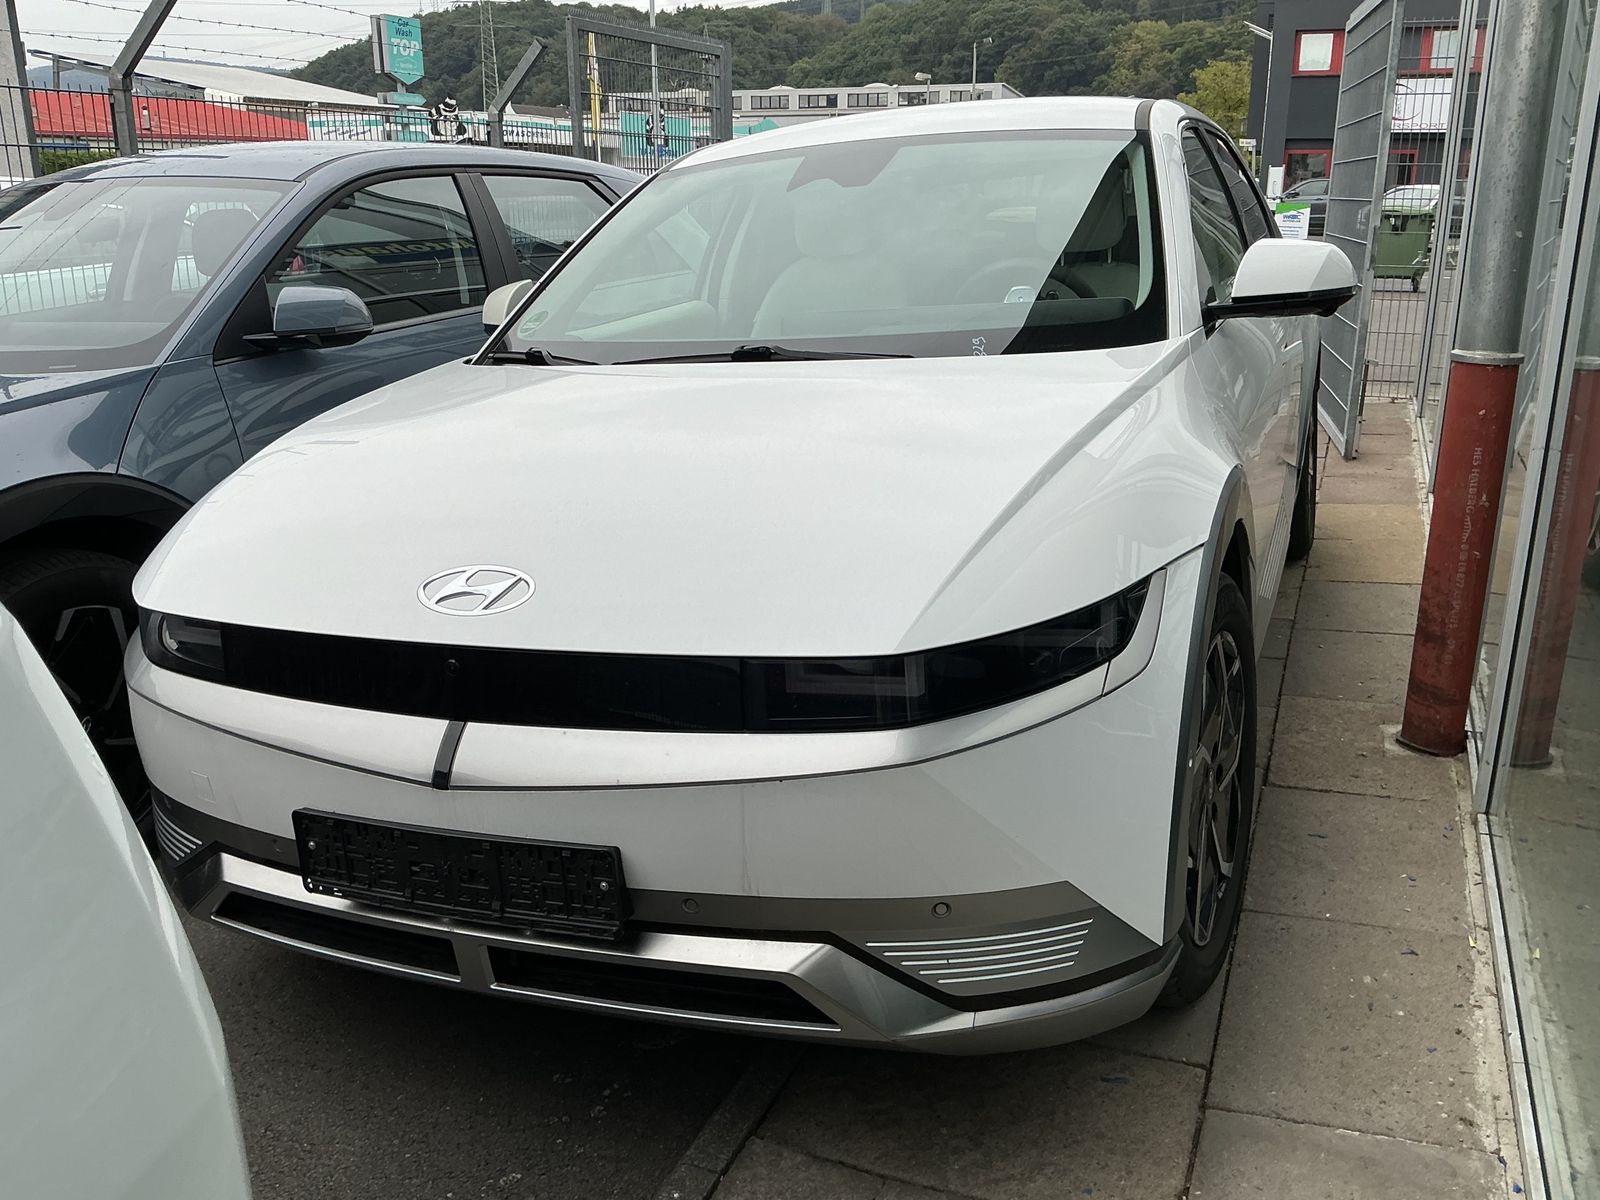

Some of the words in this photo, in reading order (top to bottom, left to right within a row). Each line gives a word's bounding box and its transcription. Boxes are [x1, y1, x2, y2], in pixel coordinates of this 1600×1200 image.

[397, 18, 409, 27] Car
[395, 28, 412, 37] Wash
[391, 38, 420, 57] TOP
[1473, 447, 1483, 466] HES
[1466, 469, 1480, 514] HALBERG
